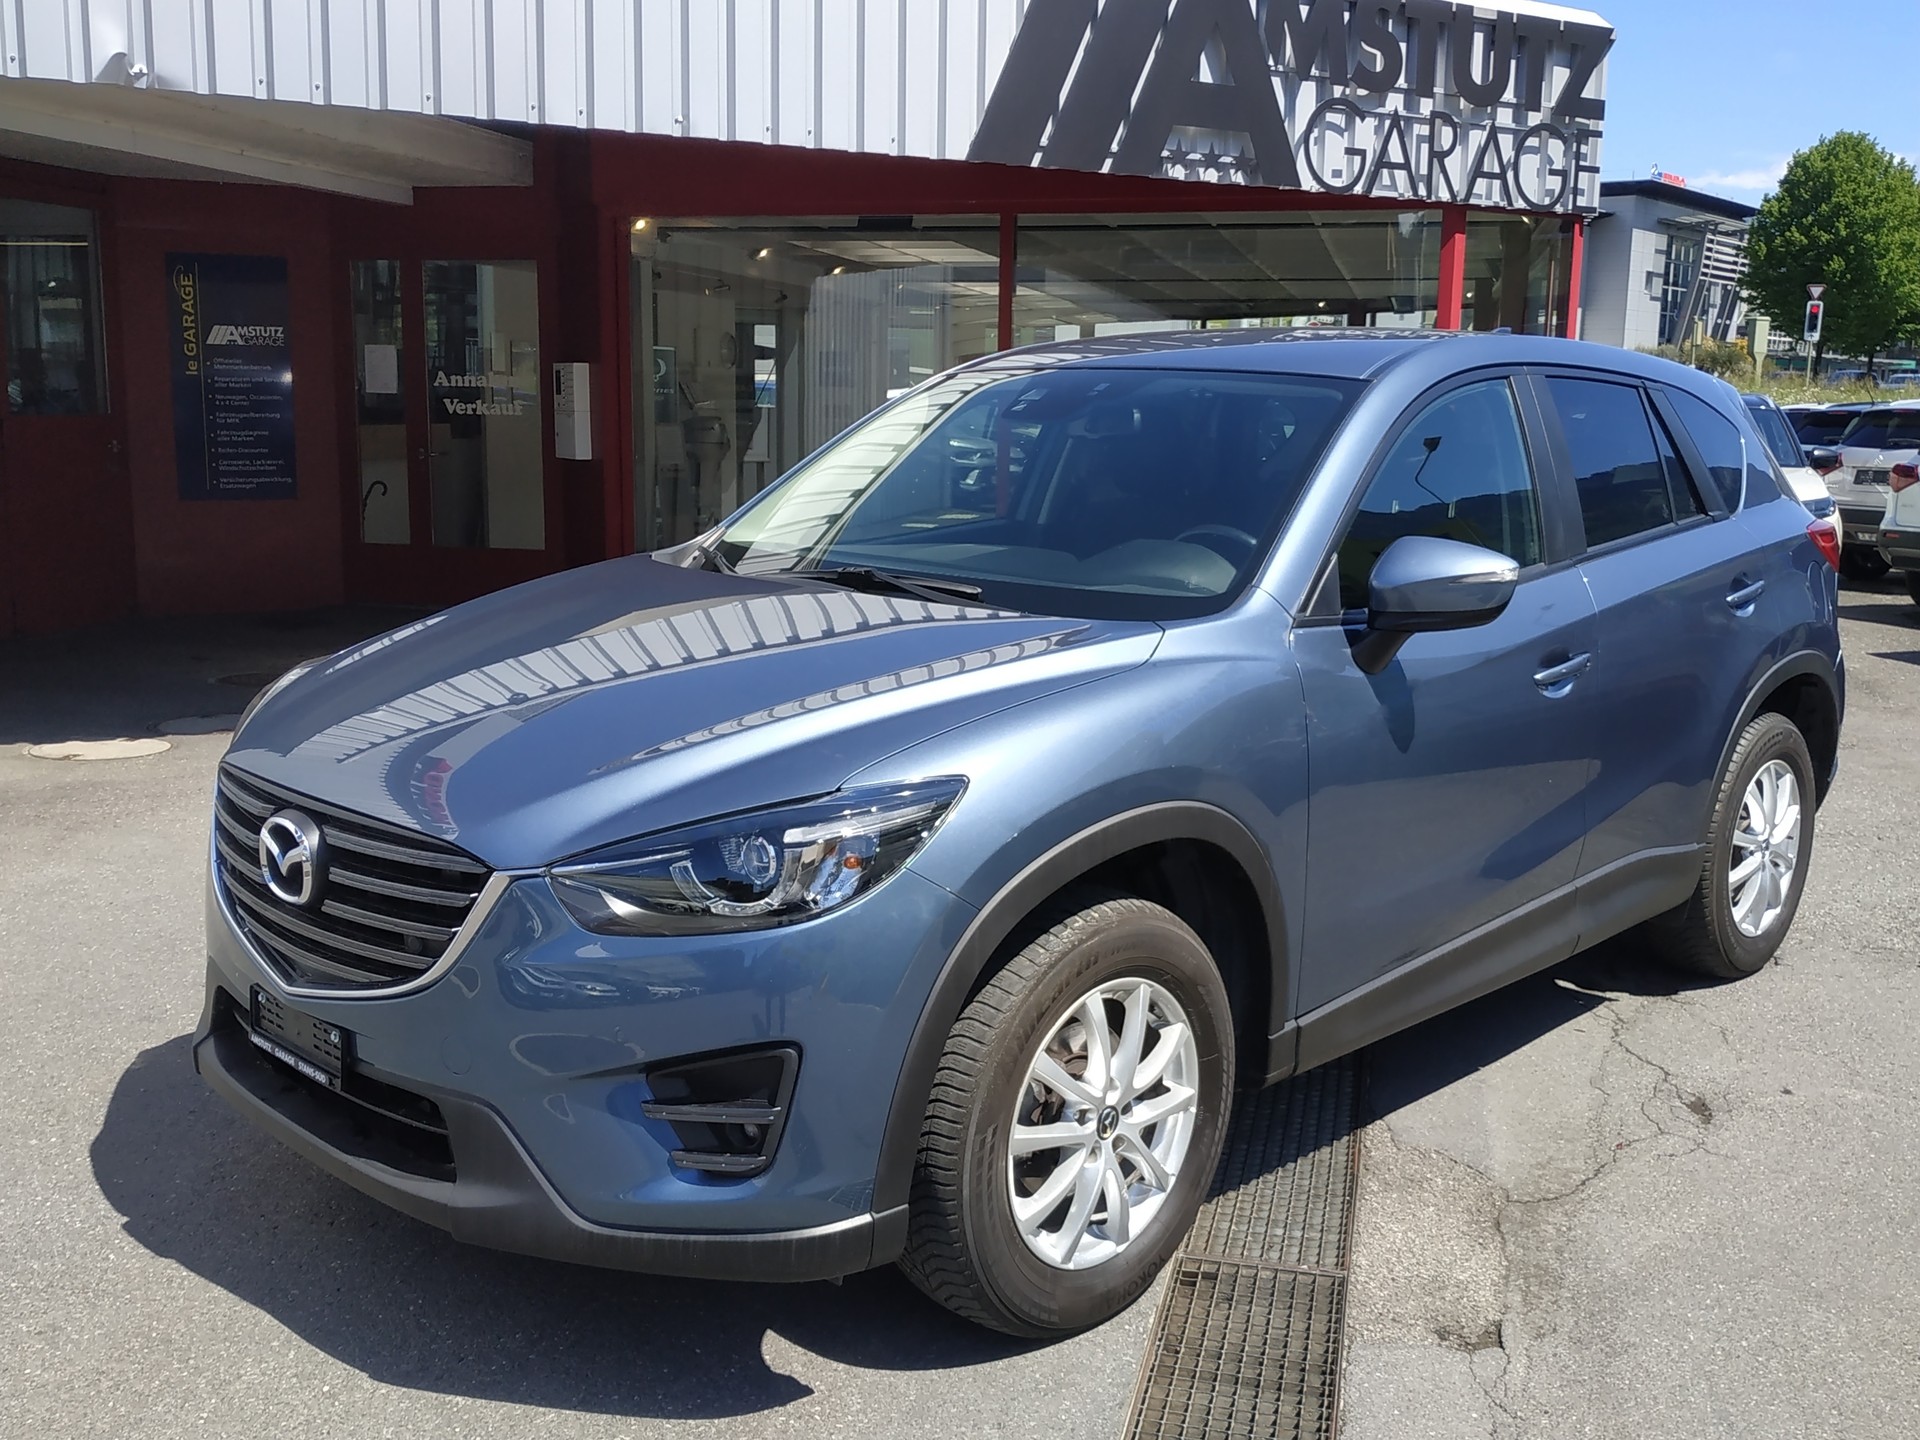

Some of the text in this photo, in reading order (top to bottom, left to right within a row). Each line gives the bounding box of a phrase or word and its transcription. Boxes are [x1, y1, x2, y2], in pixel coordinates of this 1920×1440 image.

[1102, 0, 1616, 188] AMSTUTZ
[1303, 96, 1605, 214] GARAGE
[180, 273, 198, 375] le GARAGE
[220, 325, 284, 346] AMSTUTZ
[244, 336, 285, 347] GARAGE
[442, 398, 523, 416] Verkauf
